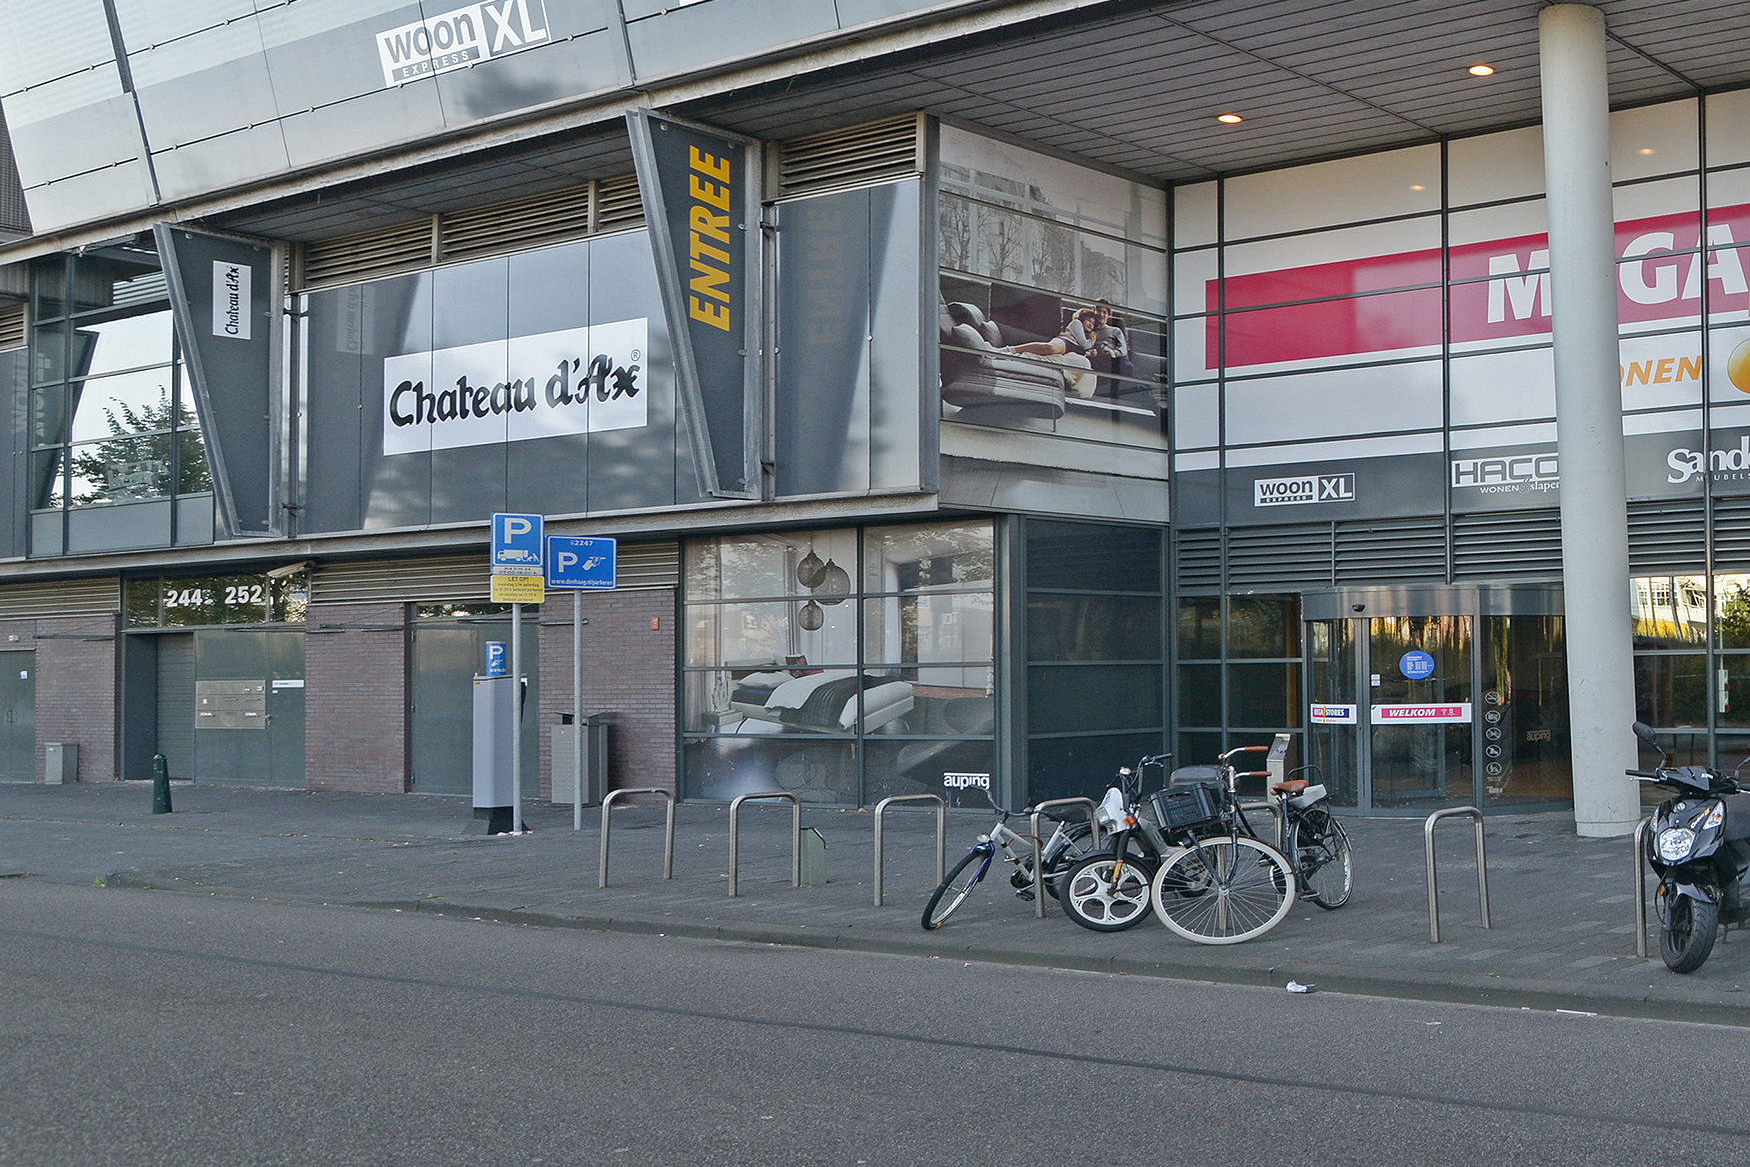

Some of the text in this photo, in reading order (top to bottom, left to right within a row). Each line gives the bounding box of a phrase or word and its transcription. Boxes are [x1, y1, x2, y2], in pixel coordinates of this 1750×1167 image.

[384, 13, 477, 64] woon
[402, 50, 469, 78] EXPRESS
[688, 145, 731, 331] ENTREE
[1487, 224, 1749, 324] MGA
[225, 293, 239, 335] Chateau
[1619, 355, 1703, 387] NEN
[389, 374, 537, 428] Chateau
[1454, 455, 1560, 485] HACO
[1259, 476, 1353, 499] woon XL
[1479, 485, 1520, 494] WONEN
[166, 585, 262, 607] 244 252
[1389, 708, 1436, 717] WELKOM
[943, 774, 990, 790] auping
